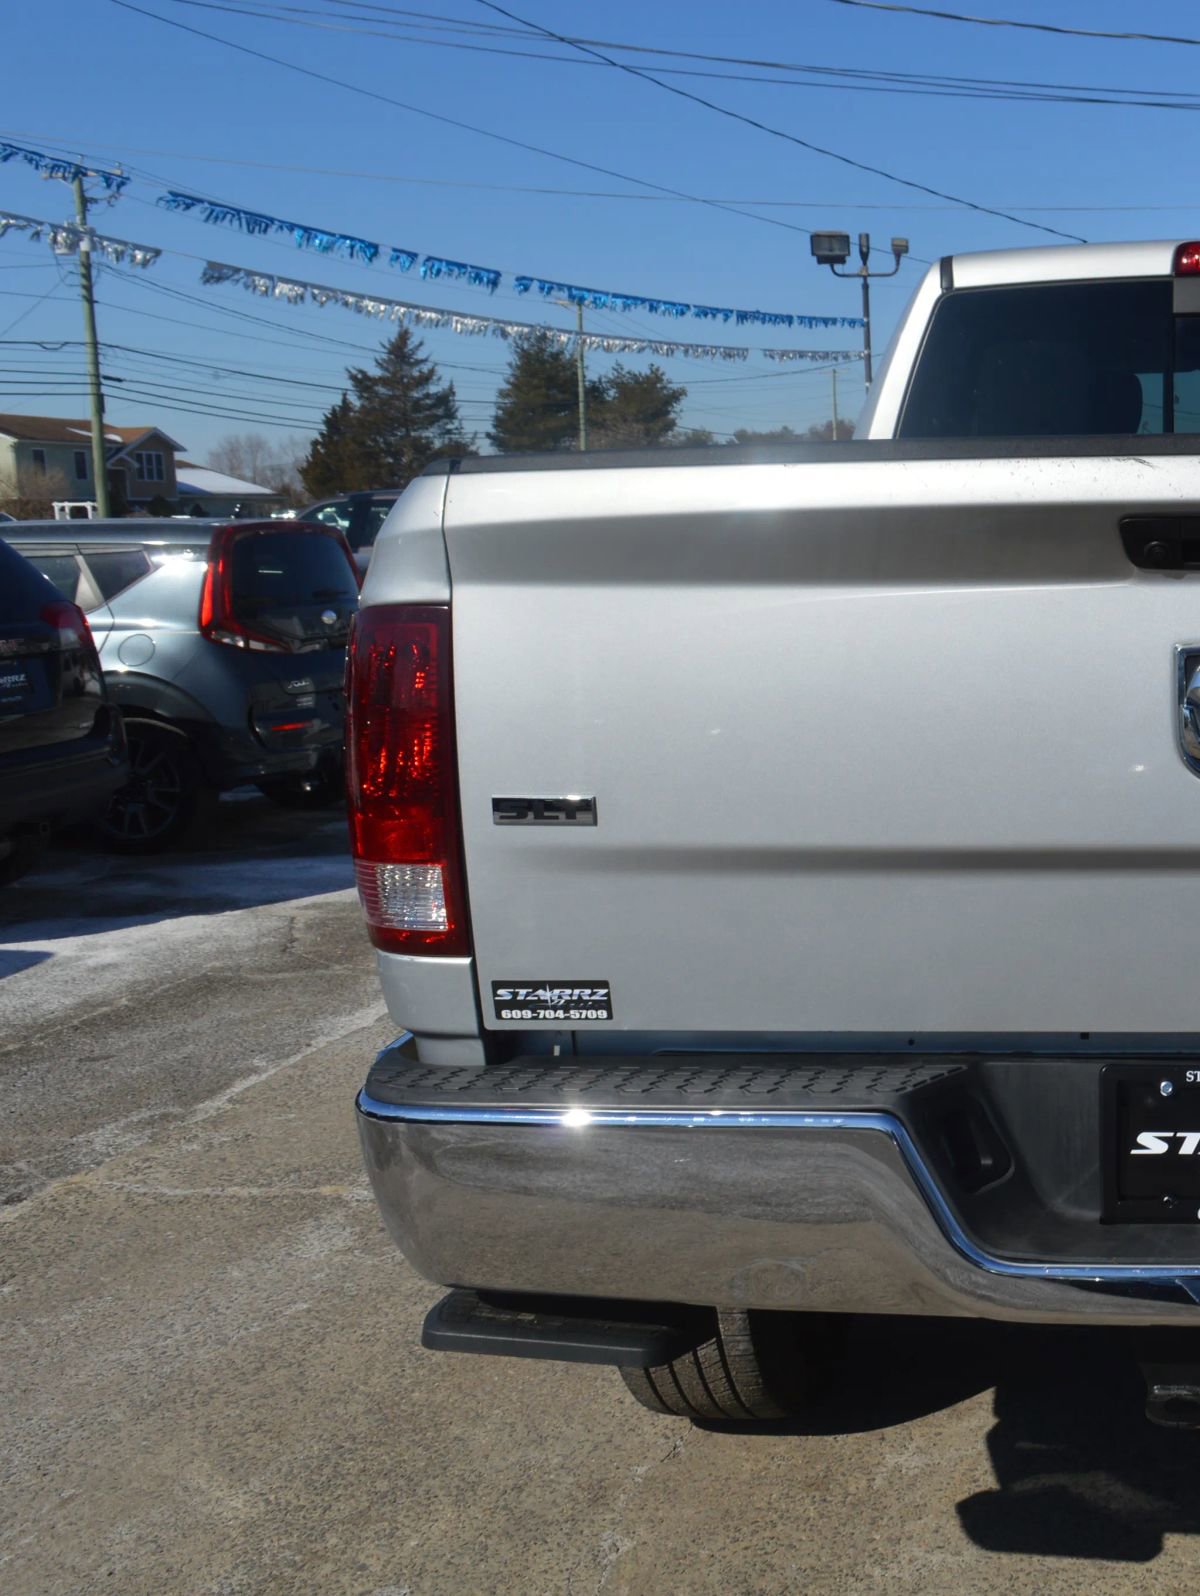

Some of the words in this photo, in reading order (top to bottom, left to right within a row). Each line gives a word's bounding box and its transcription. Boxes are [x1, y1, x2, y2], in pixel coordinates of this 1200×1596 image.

[497, 798, 590, 821] SLT
[494, 988, 609, 1001] STARRZ
[501, 1009, 608, 1019] 609-704-5709
